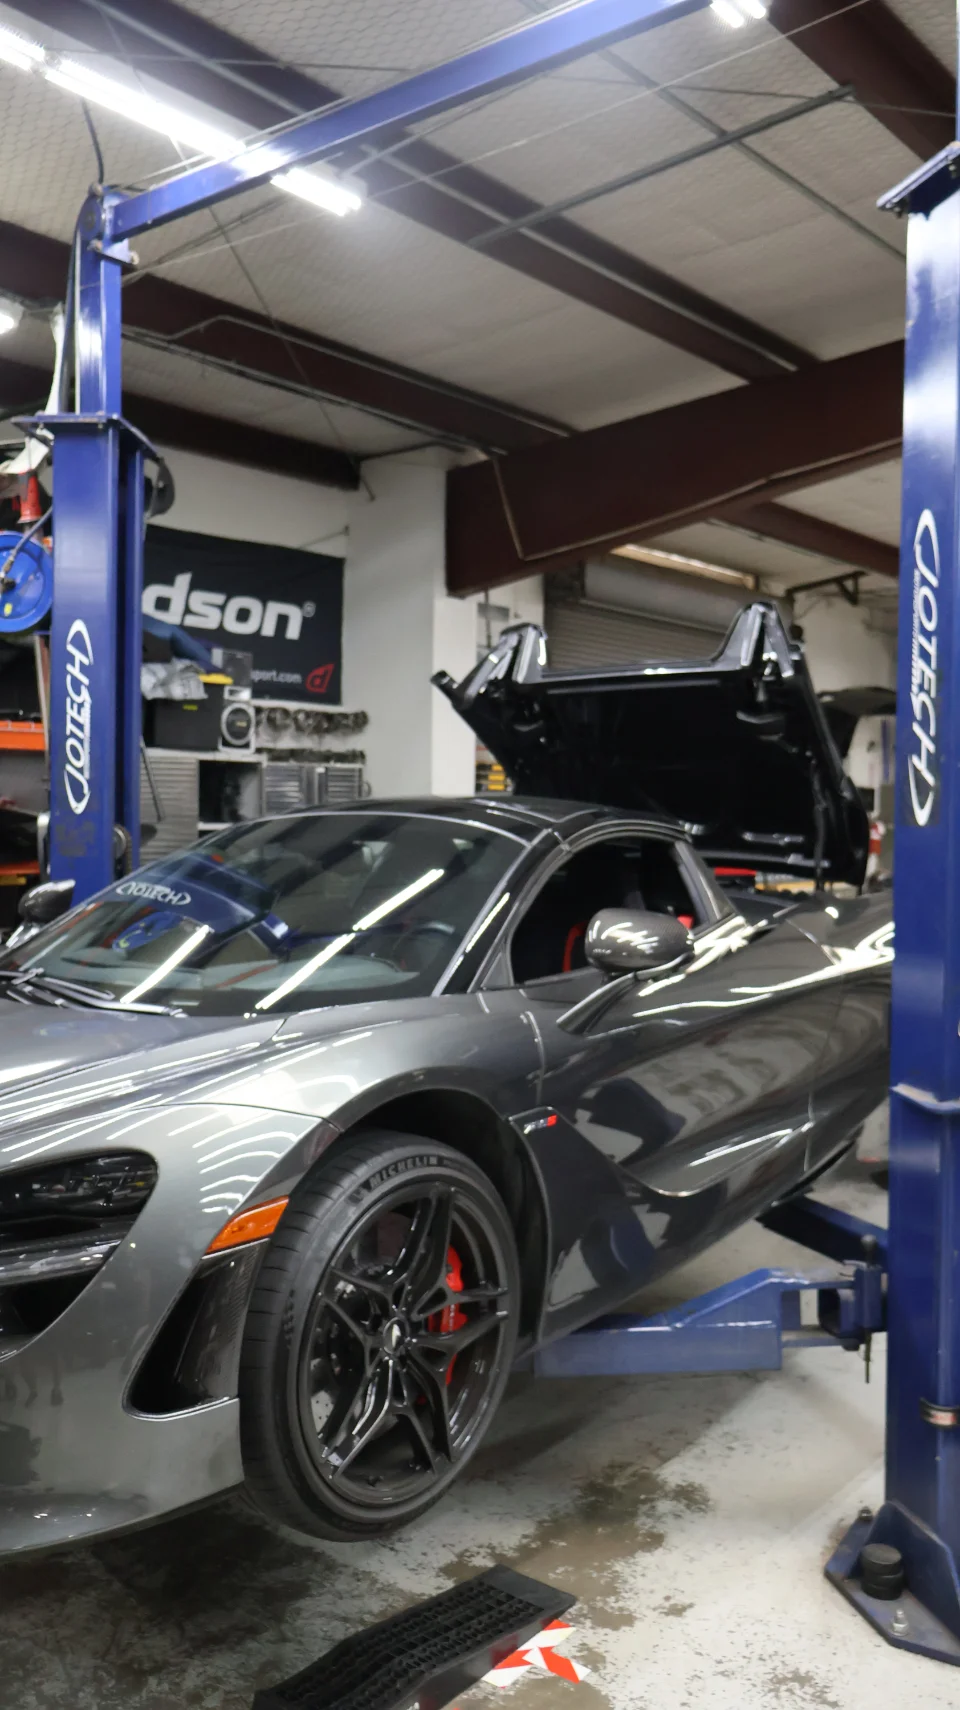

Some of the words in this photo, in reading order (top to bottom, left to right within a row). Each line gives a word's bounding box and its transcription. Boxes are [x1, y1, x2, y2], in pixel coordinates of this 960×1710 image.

[65, 640, 91, 796] JOTECH
[911, 540, 939, 790] JOTECH
[369, 1156, 438, 1189] MICHELIN
